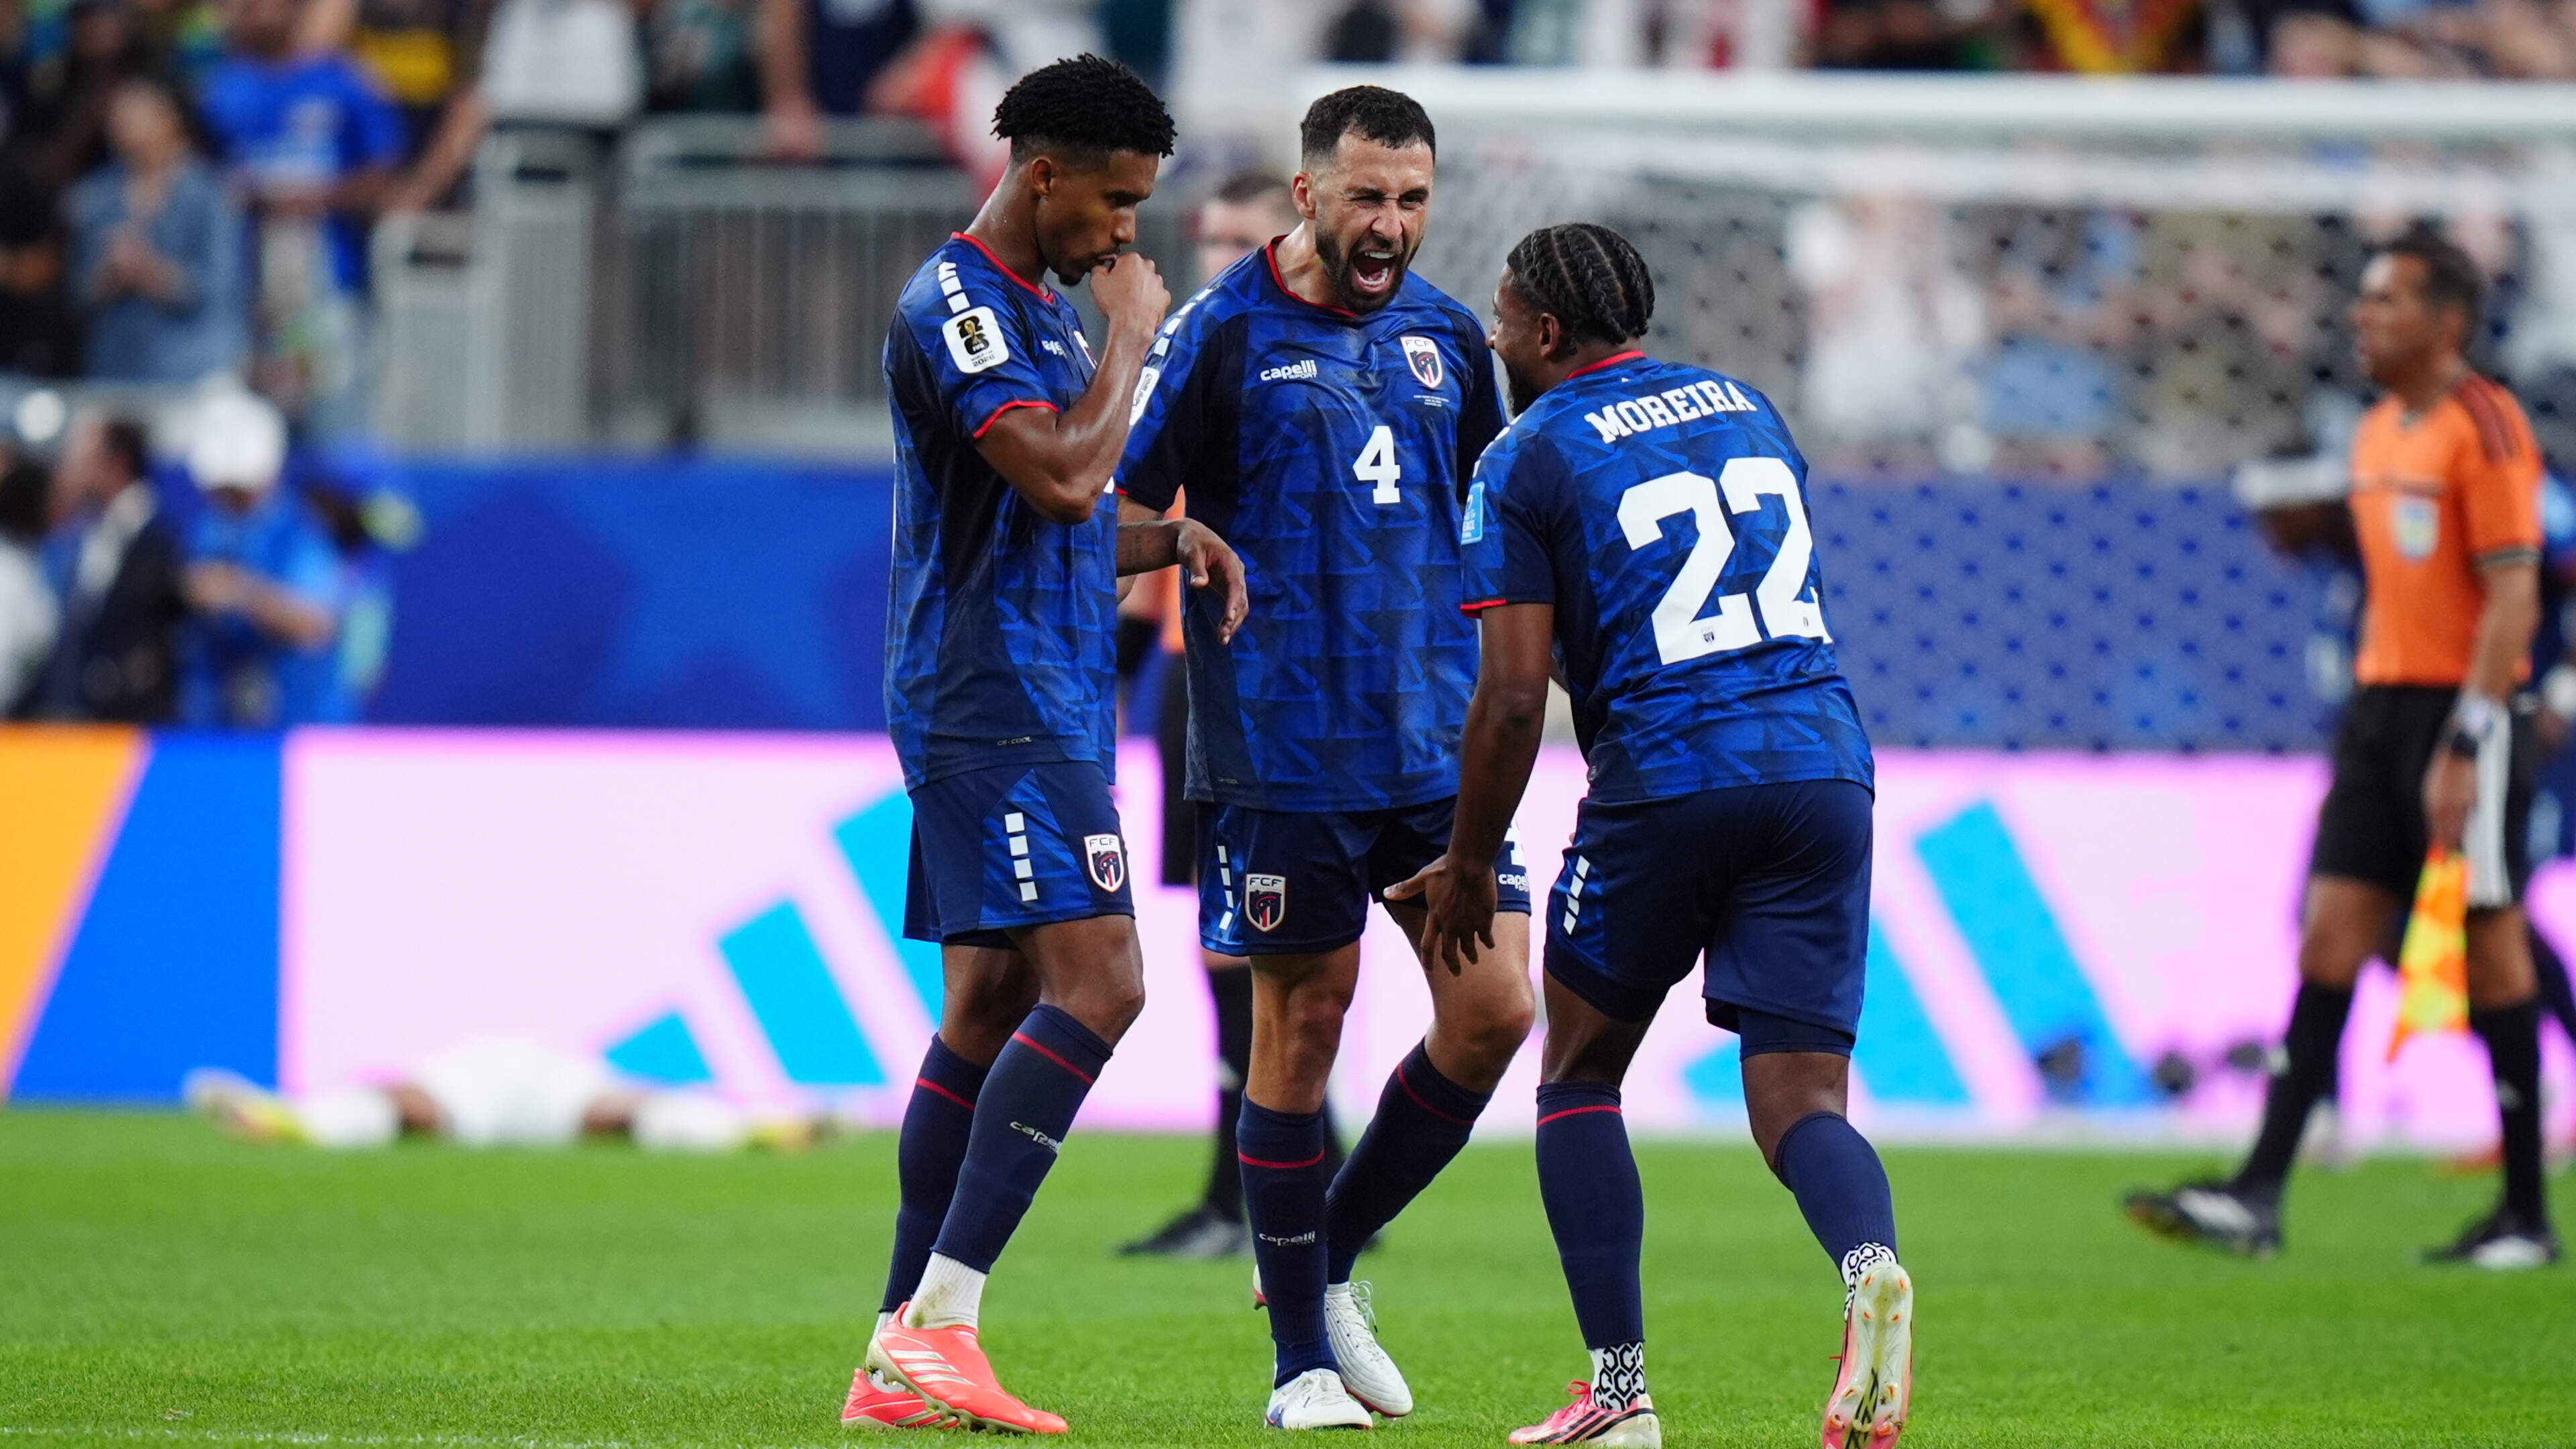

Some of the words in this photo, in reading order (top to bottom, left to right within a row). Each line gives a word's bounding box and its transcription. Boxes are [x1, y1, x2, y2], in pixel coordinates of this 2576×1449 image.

[1260, 359, 1318, 382] capelli
[1584, 380, 1758, 444] MOREIRA
[1352, 425, 1401, 504] 4
[1617, 457, 1833, 665] 22
[1089, 837, 1117, 848] FCF
[1250, 877, 1283, 886] FCF
[1259, 1230, 1316, 1246] capelli
